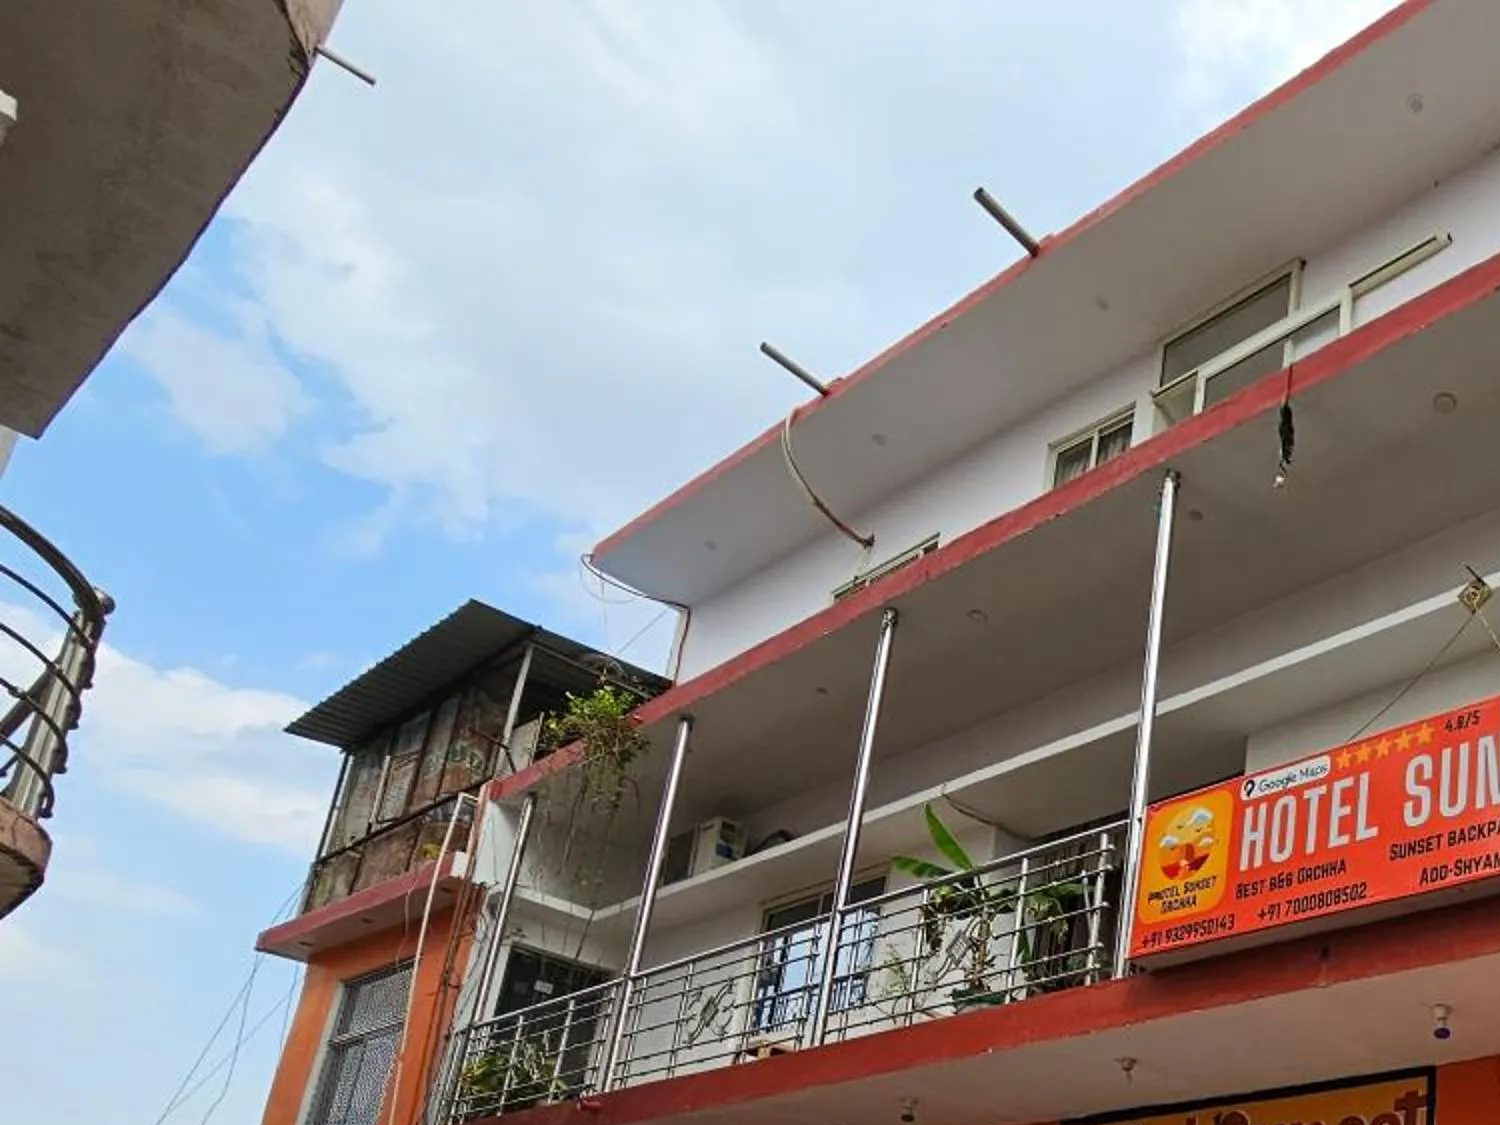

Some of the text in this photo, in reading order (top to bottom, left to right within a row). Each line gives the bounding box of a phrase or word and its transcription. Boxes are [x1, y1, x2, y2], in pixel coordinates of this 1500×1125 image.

[1238, 773, 1379, 872] HOTEL
[1389, 834, 1443, 861] SUNSET
[1235, 879, 1265, 901] BEST
[1297, 859, 1348, 886] ORCHHA
[1257, 902, 1281, 921] +91
